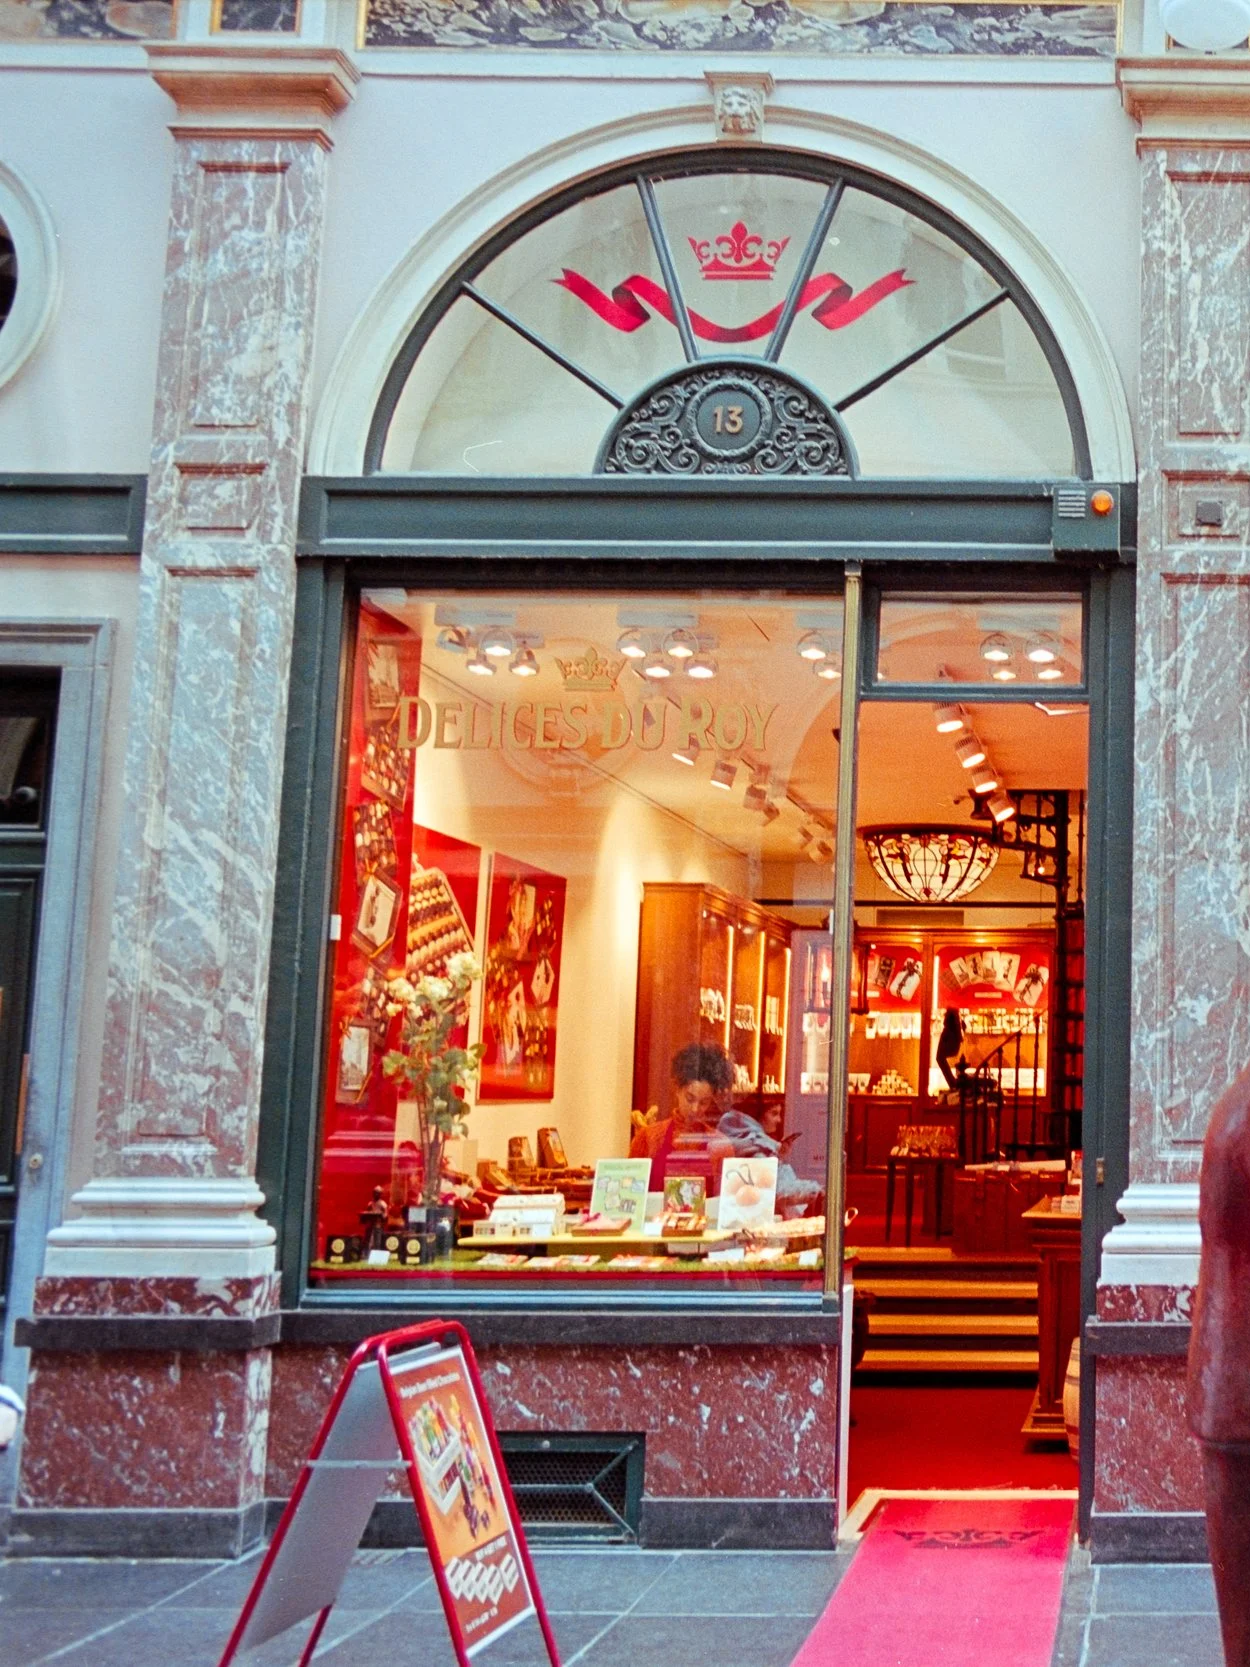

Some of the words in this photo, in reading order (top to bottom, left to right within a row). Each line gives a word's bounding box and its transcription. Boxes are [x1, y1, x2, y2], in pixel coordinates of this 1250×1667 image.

[713, 405, 744, 434] 13
[399, 696, 588, 750] DELICES
[600, 702, 667, 751] DU
[679, 698, 779, 751] ROY
